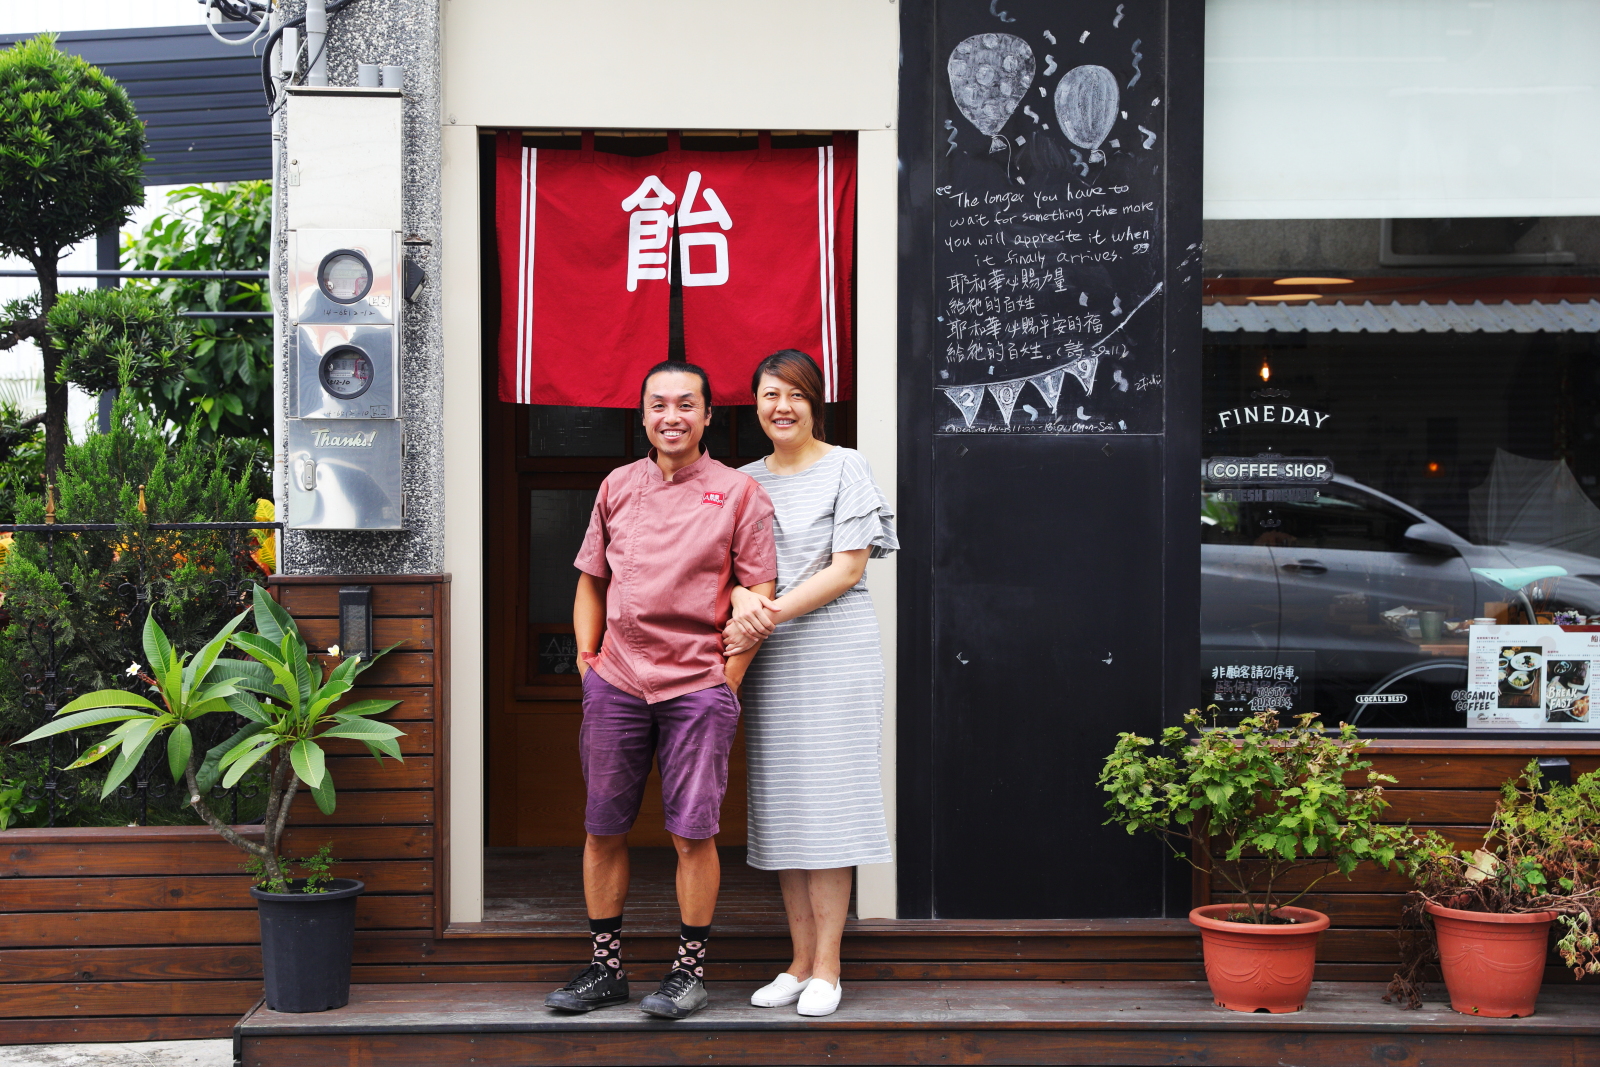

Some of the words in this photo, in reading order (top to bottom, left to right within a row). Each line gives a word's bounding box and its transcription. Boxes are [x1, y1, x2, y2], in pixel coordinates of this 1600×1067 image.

[984, 191, 1024, 211] longer
[1067, 183, 1106, 201] have
[1108, 184, 1129, 194] to
[949, 213, 990, 228] wait
[994, 212, 1017, 227] for
[1022, 207, 1084, 224] something
[1087, 202, 1118, 217] the
[1122, 201, 1154, 215] more
[621, 170, 733, 292] 飴
[944, 236, 971, 252] you
[978, 231, 1005, 246] will
[1088, 230, 1107, 245] it
[1111, 227, 1150, 242] when
[973, 255, 996, 267] it
[1004, 250, 1047, 269] finally
[311, 428, 377, 447] Thanks!
[1213, 463, 1278, 477] COFFEE
[1285, 463, 1327, 477] SHOP
[1257, 686, 1286, 697] TASTY
[1451, 690, 1496, 701] ORGANIC
[1547, 686, 1578, 699] BREAK
[1251, 696, 1293, 708] BURGERS
[1359, 695, 1387, 703] LOCAL'S
[1387, 695, 1404, 703] BEST
[1549, 698, 1573, 710] FAST
[1455, 701, 1490, 711] COFFEE
